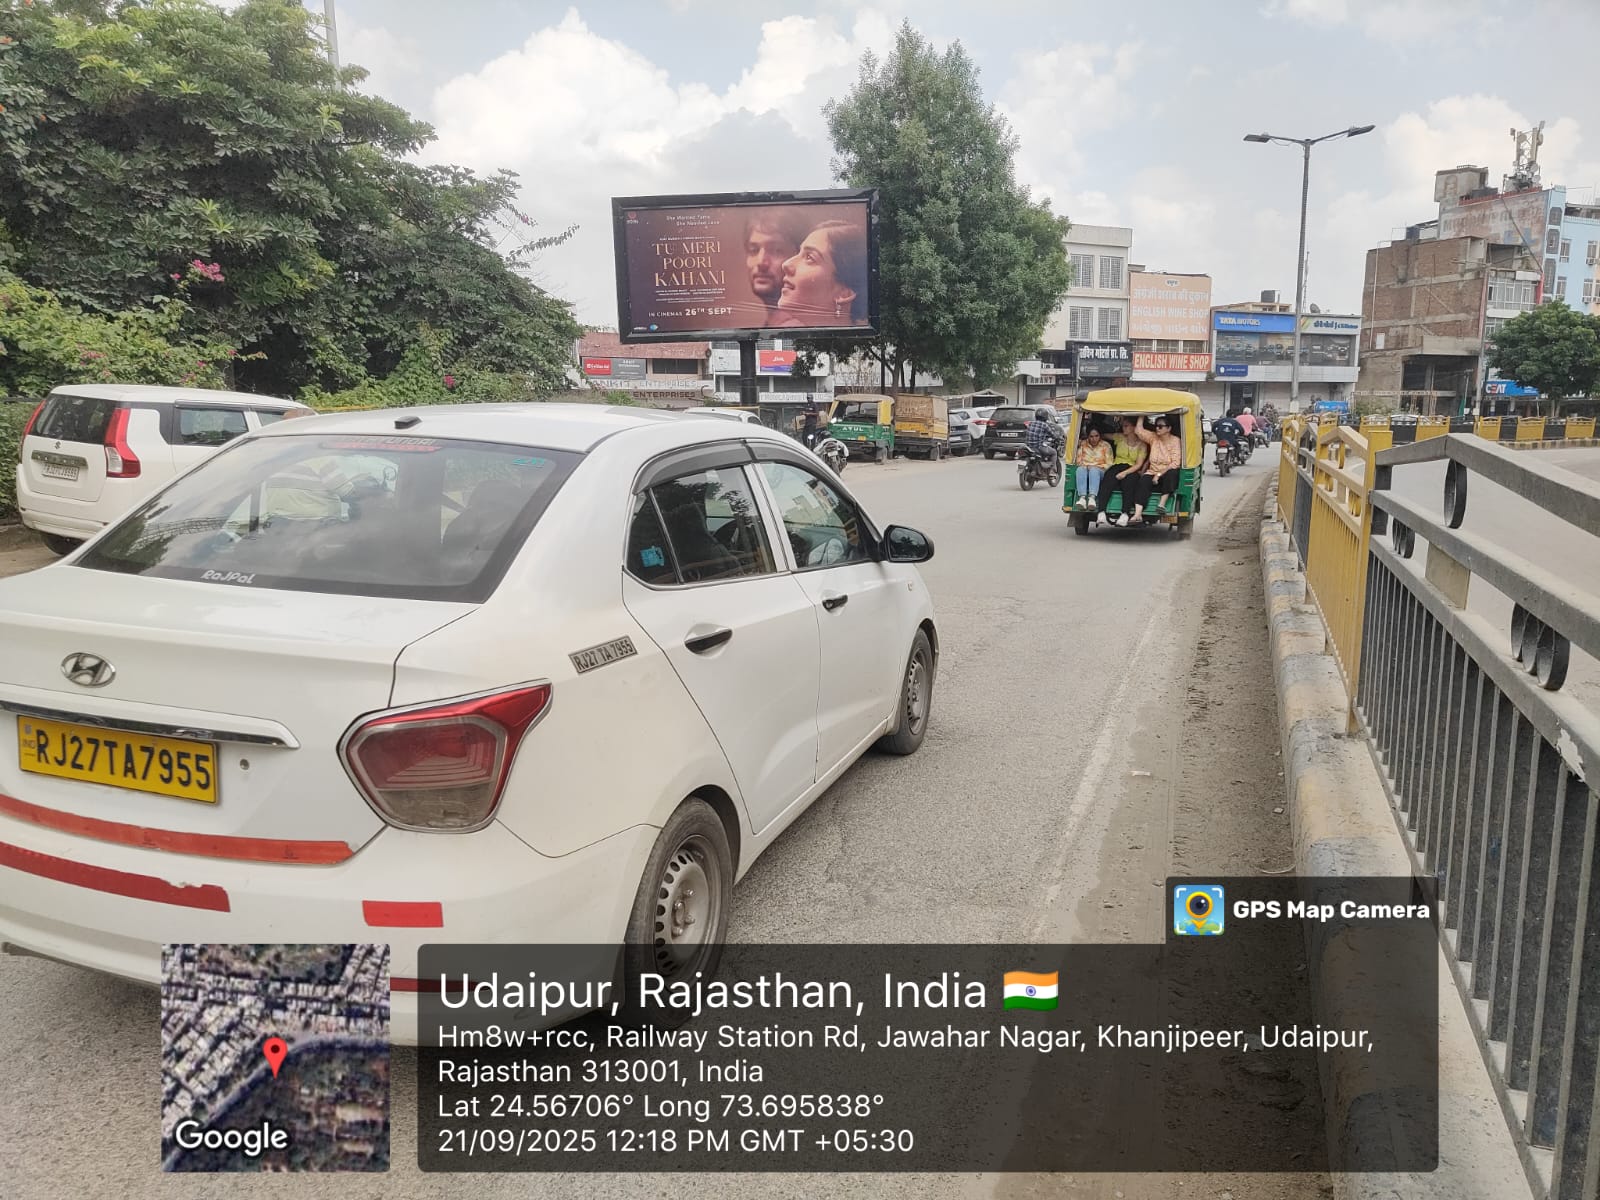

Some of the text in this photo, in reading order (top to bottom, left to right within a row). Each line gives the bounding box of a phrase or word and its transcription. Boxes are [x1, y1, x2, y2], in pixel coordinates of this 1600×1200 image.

[652, 240, 720, 255] TU MERI
[663, 256, 712, 270] POORI
[655, 270, 725, 286] KAHANI
[685, 308, 705, 316] 26TH
[708, 306, 732, 315] SEPT
[1220, 317, 1261, 326] TATA MOTORS
[1134, 354, 1168, 369] ENGLISH
[1169, 354, 1188, 369] WINE
[1190, 356, 1209, 370] SHOP
[1486, 383, 1507, 394] CEAT
[573, 639, 634, 670] RJ27 TA 7955
[36, 729, 210, 790] RJ27TA7955
